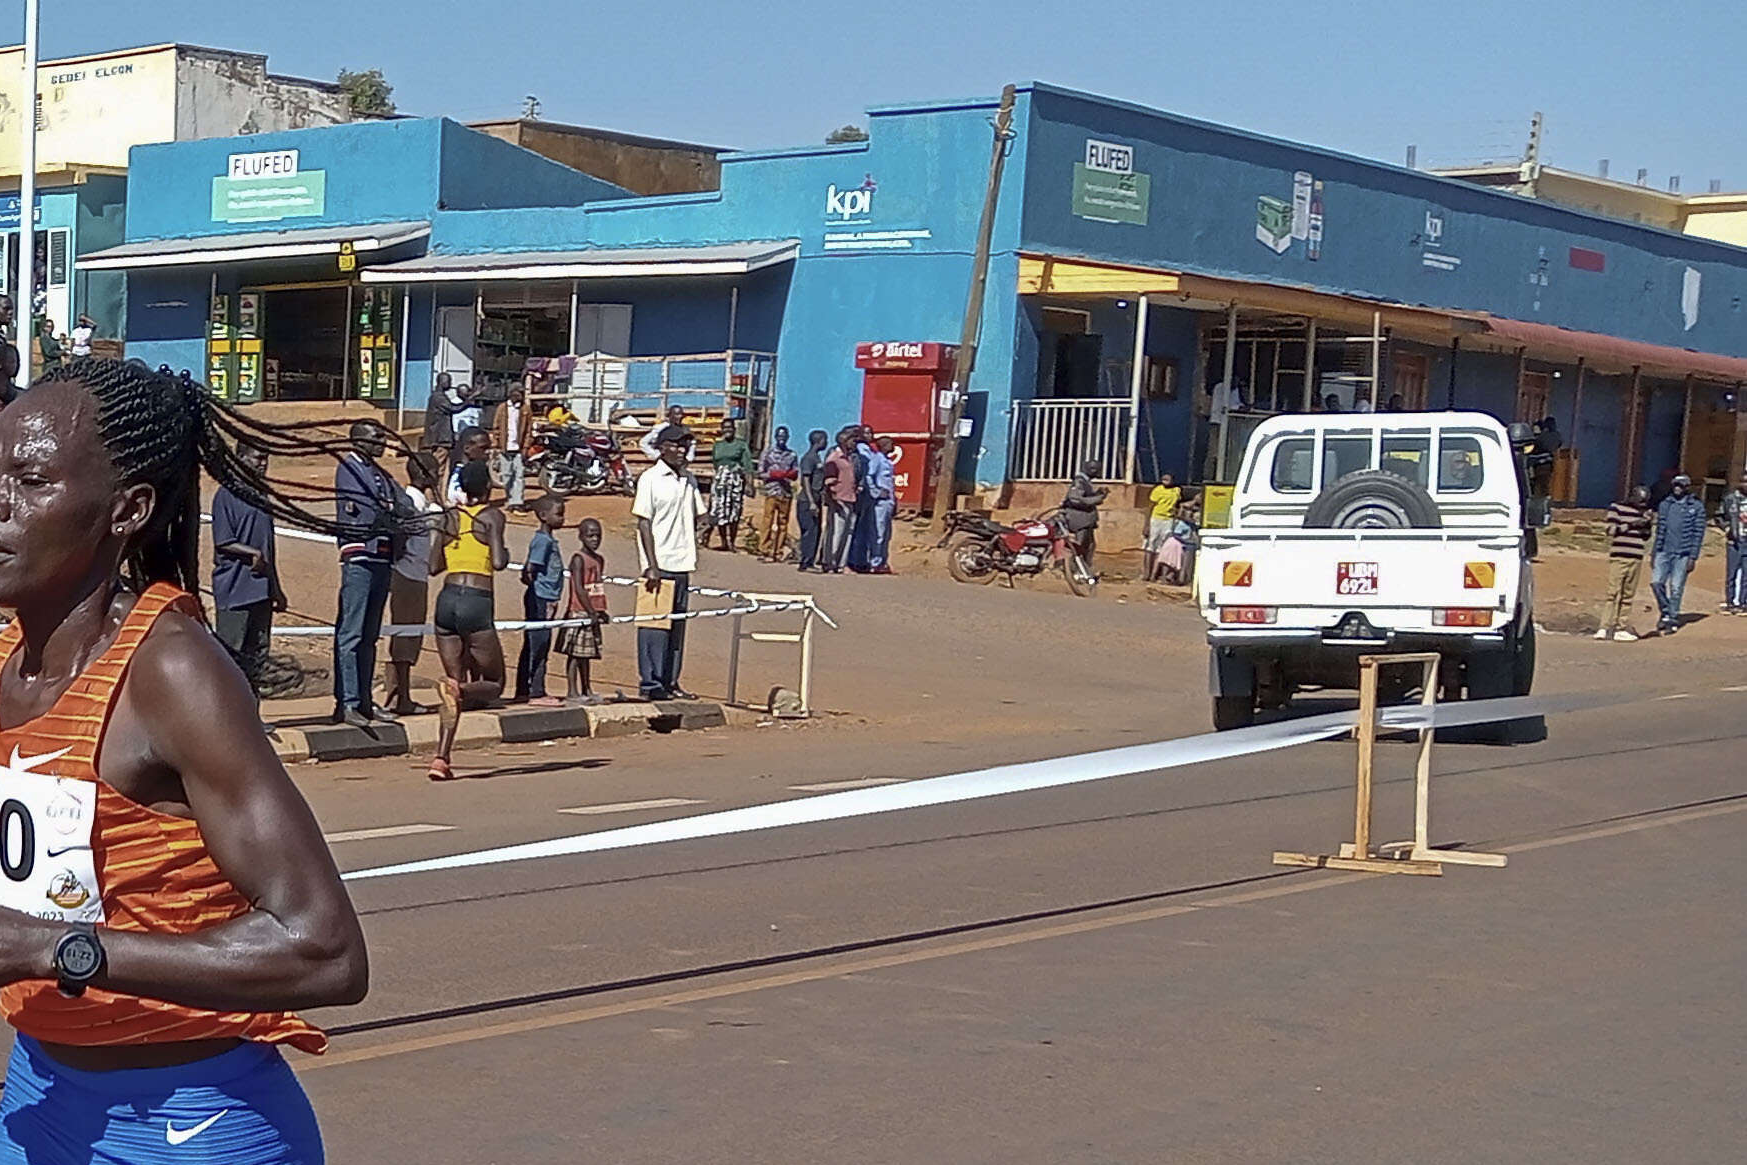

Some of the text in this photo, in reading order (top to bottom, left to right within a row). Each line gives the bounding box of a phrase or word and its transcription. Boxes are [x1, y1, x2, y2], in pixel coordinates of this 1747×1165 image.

[234, 155, 293, 176] FLUFED
[1088, 144, 1130, 170] FLUFED
[826, 184, 871, 220] kpi
